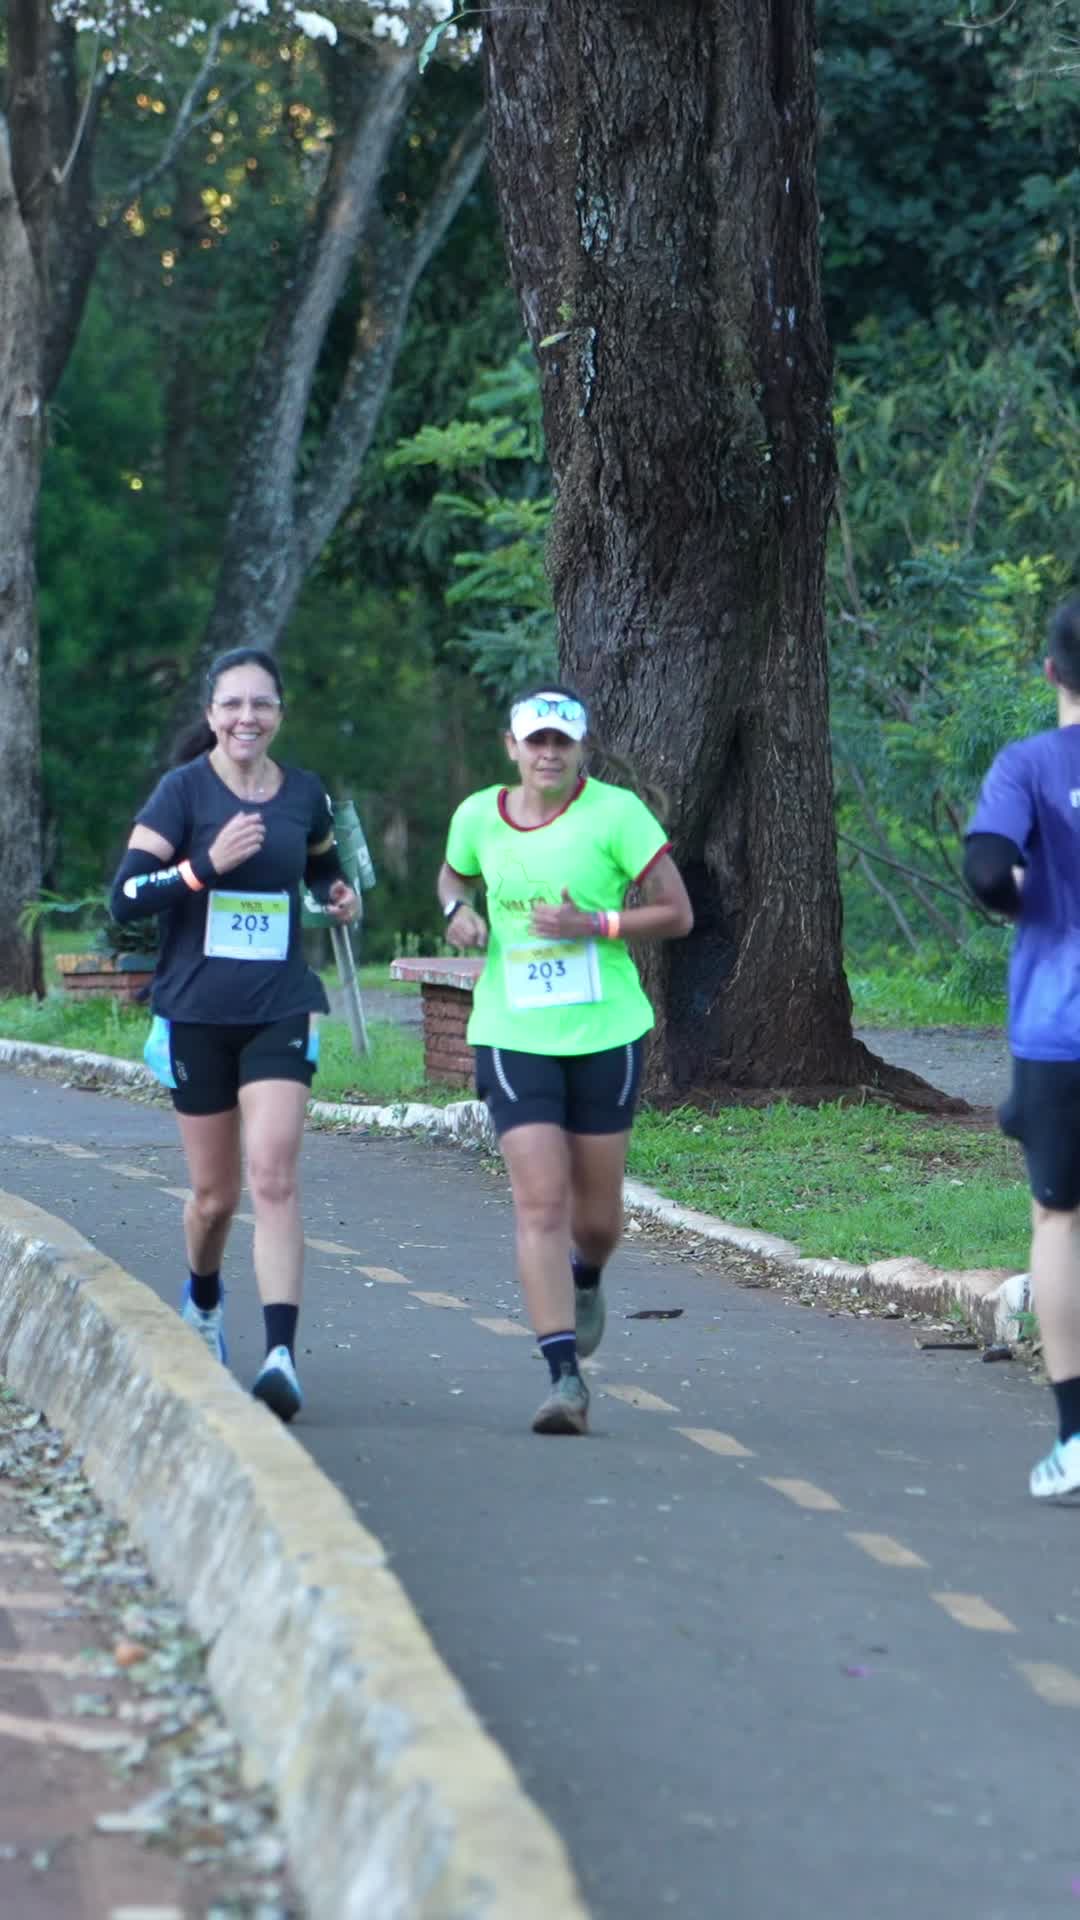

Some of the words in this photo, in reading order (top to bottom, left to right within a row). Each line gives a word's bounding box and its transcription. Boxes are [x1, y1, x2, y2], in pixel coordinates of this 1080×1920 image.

[231, 913, 270, 932] 203
[248, 934, 253, 945] 1
[528, 960, 566, 980] 203
[544, 981, 553, 993] 3
